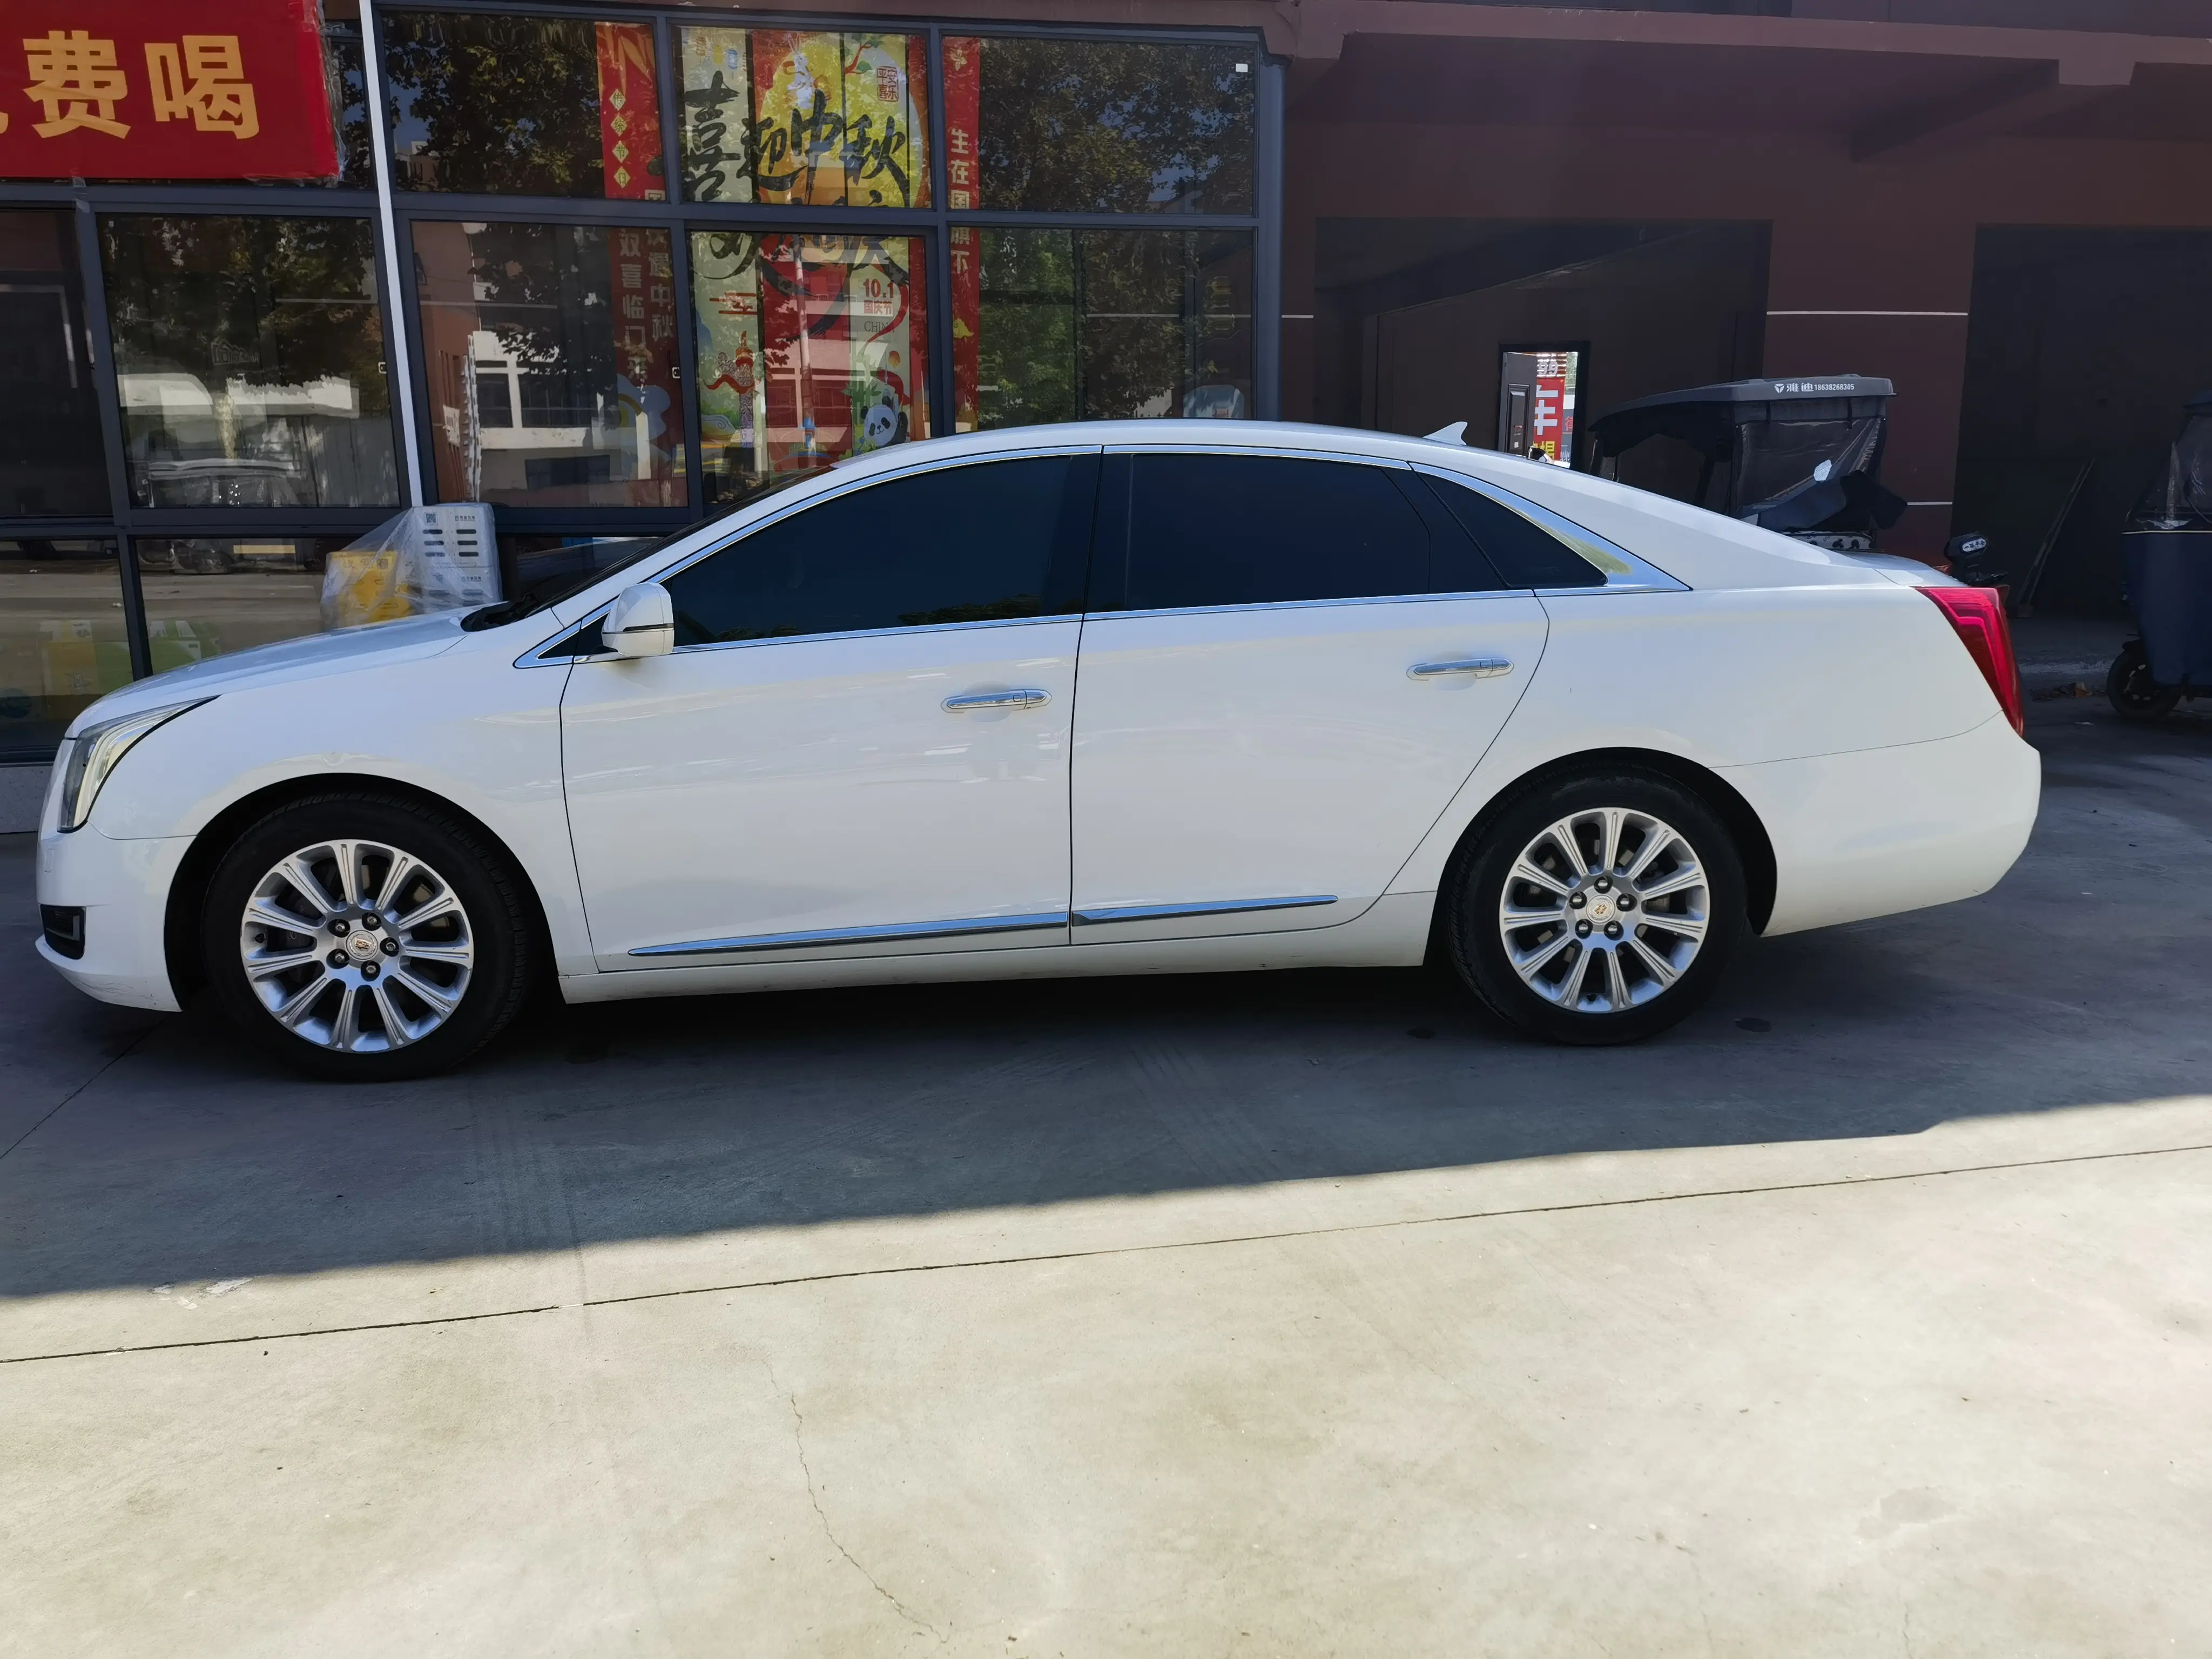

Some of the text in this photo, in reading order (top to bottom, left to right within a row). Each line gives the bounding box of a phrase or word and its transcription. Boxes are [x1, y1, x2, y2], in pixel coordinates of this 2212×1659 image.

[0, 30, 259, 139] 费喝
[863, 278, 894, 298] 10.1
[864, 300, 893, 315] 国庆节
[864, 321, 895, 333] CHIN
[1786, 382, 1814, 392] 雅迪
